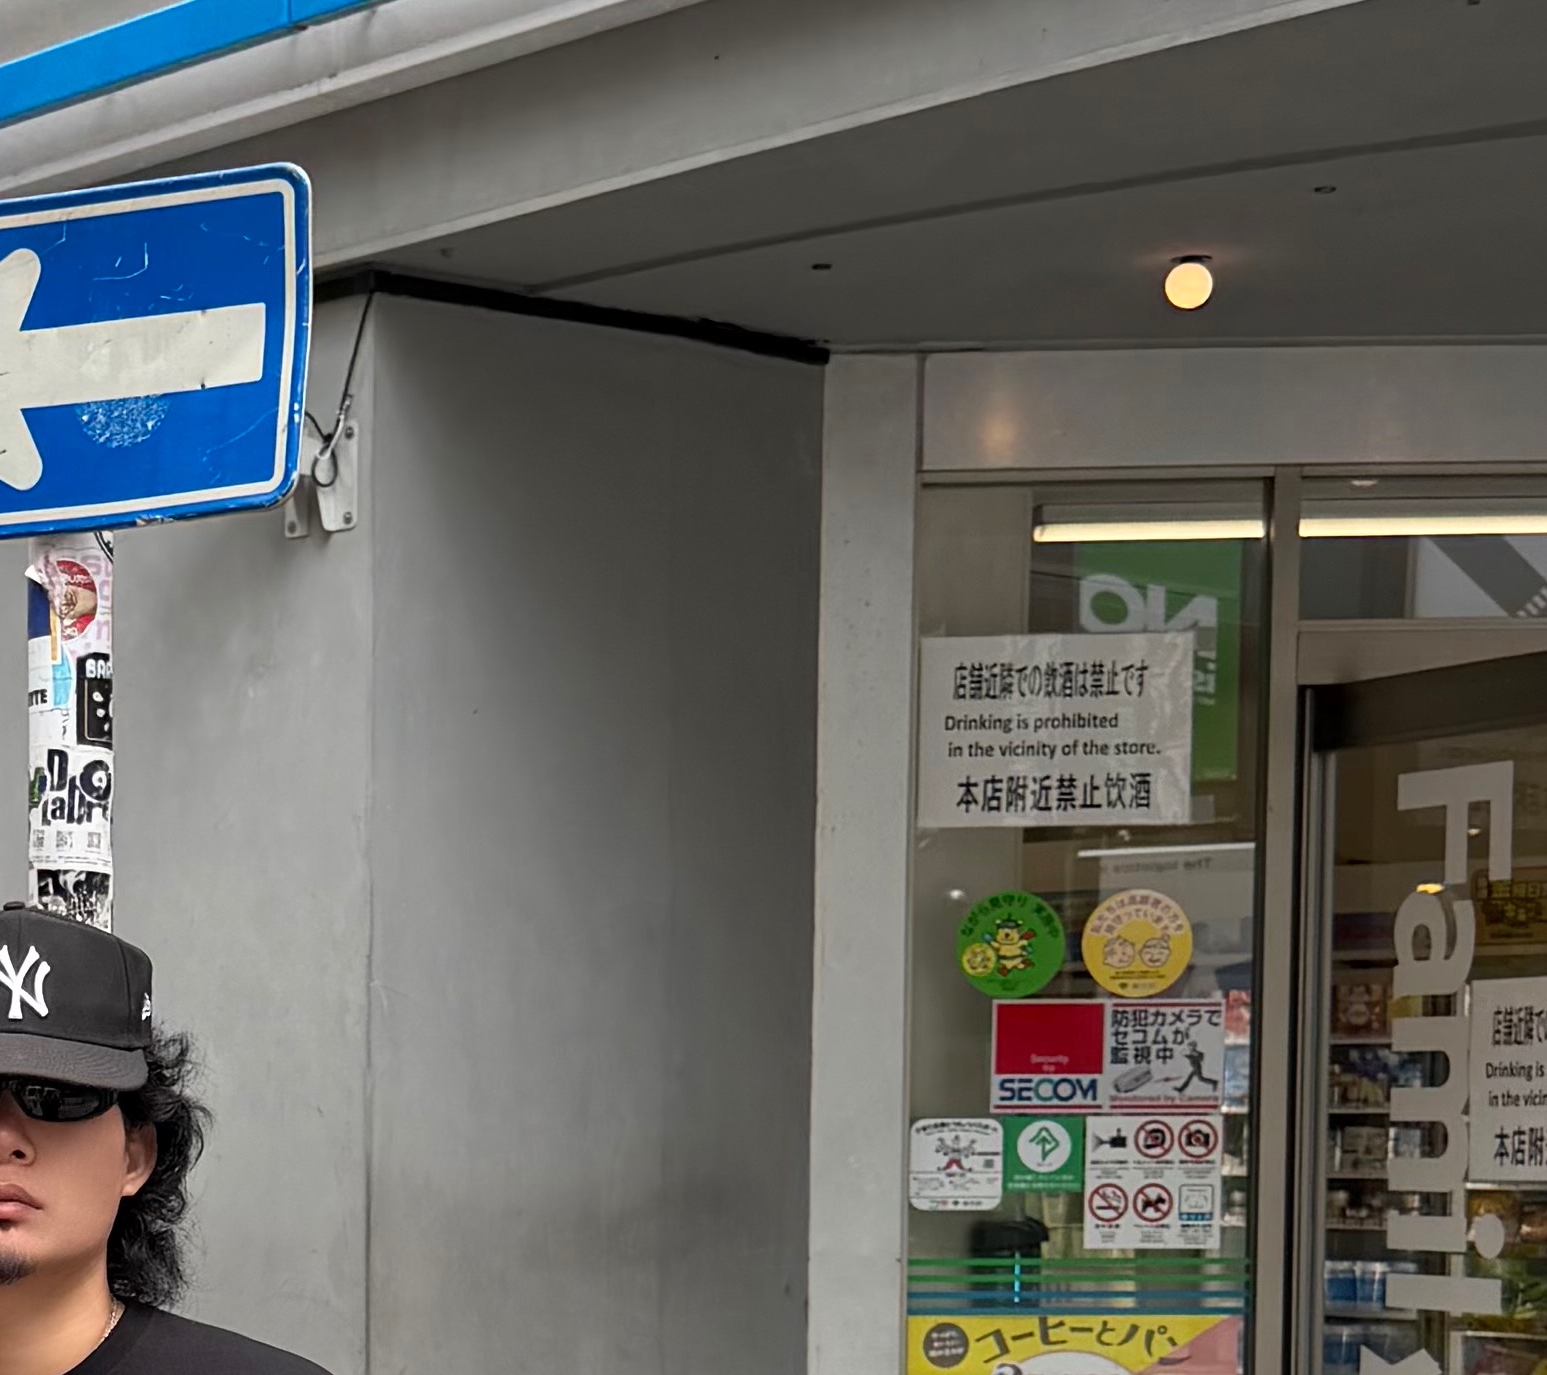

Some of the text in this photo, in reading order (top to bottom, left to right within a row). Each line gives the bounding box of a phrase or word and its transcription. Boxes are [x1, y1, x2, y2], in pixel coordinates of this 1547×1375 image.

[953, 660, 1150, 701] 店舗近隣での飲酒は禁止です
[944, 712, 1119, 733] Drinking is prohibited
[948, 740, 1161, 760] in the vicinity of the store.
[956, 772, 1152, 813] 本店附近禁止饮酒
[1110, 1008, 1221, 1028] 防犯カメラで
[1110, 1027, 1191, 1046] セコムが
[1109, 1045, 1175, 1065] 監視中
[1485, 1061, 1533, 1081] Drinking
[998, 1077, 1099, 1102] SECOM
[1488, 1091, 1501, 1107] in
[1501, 1090, 1521, 1107] the
